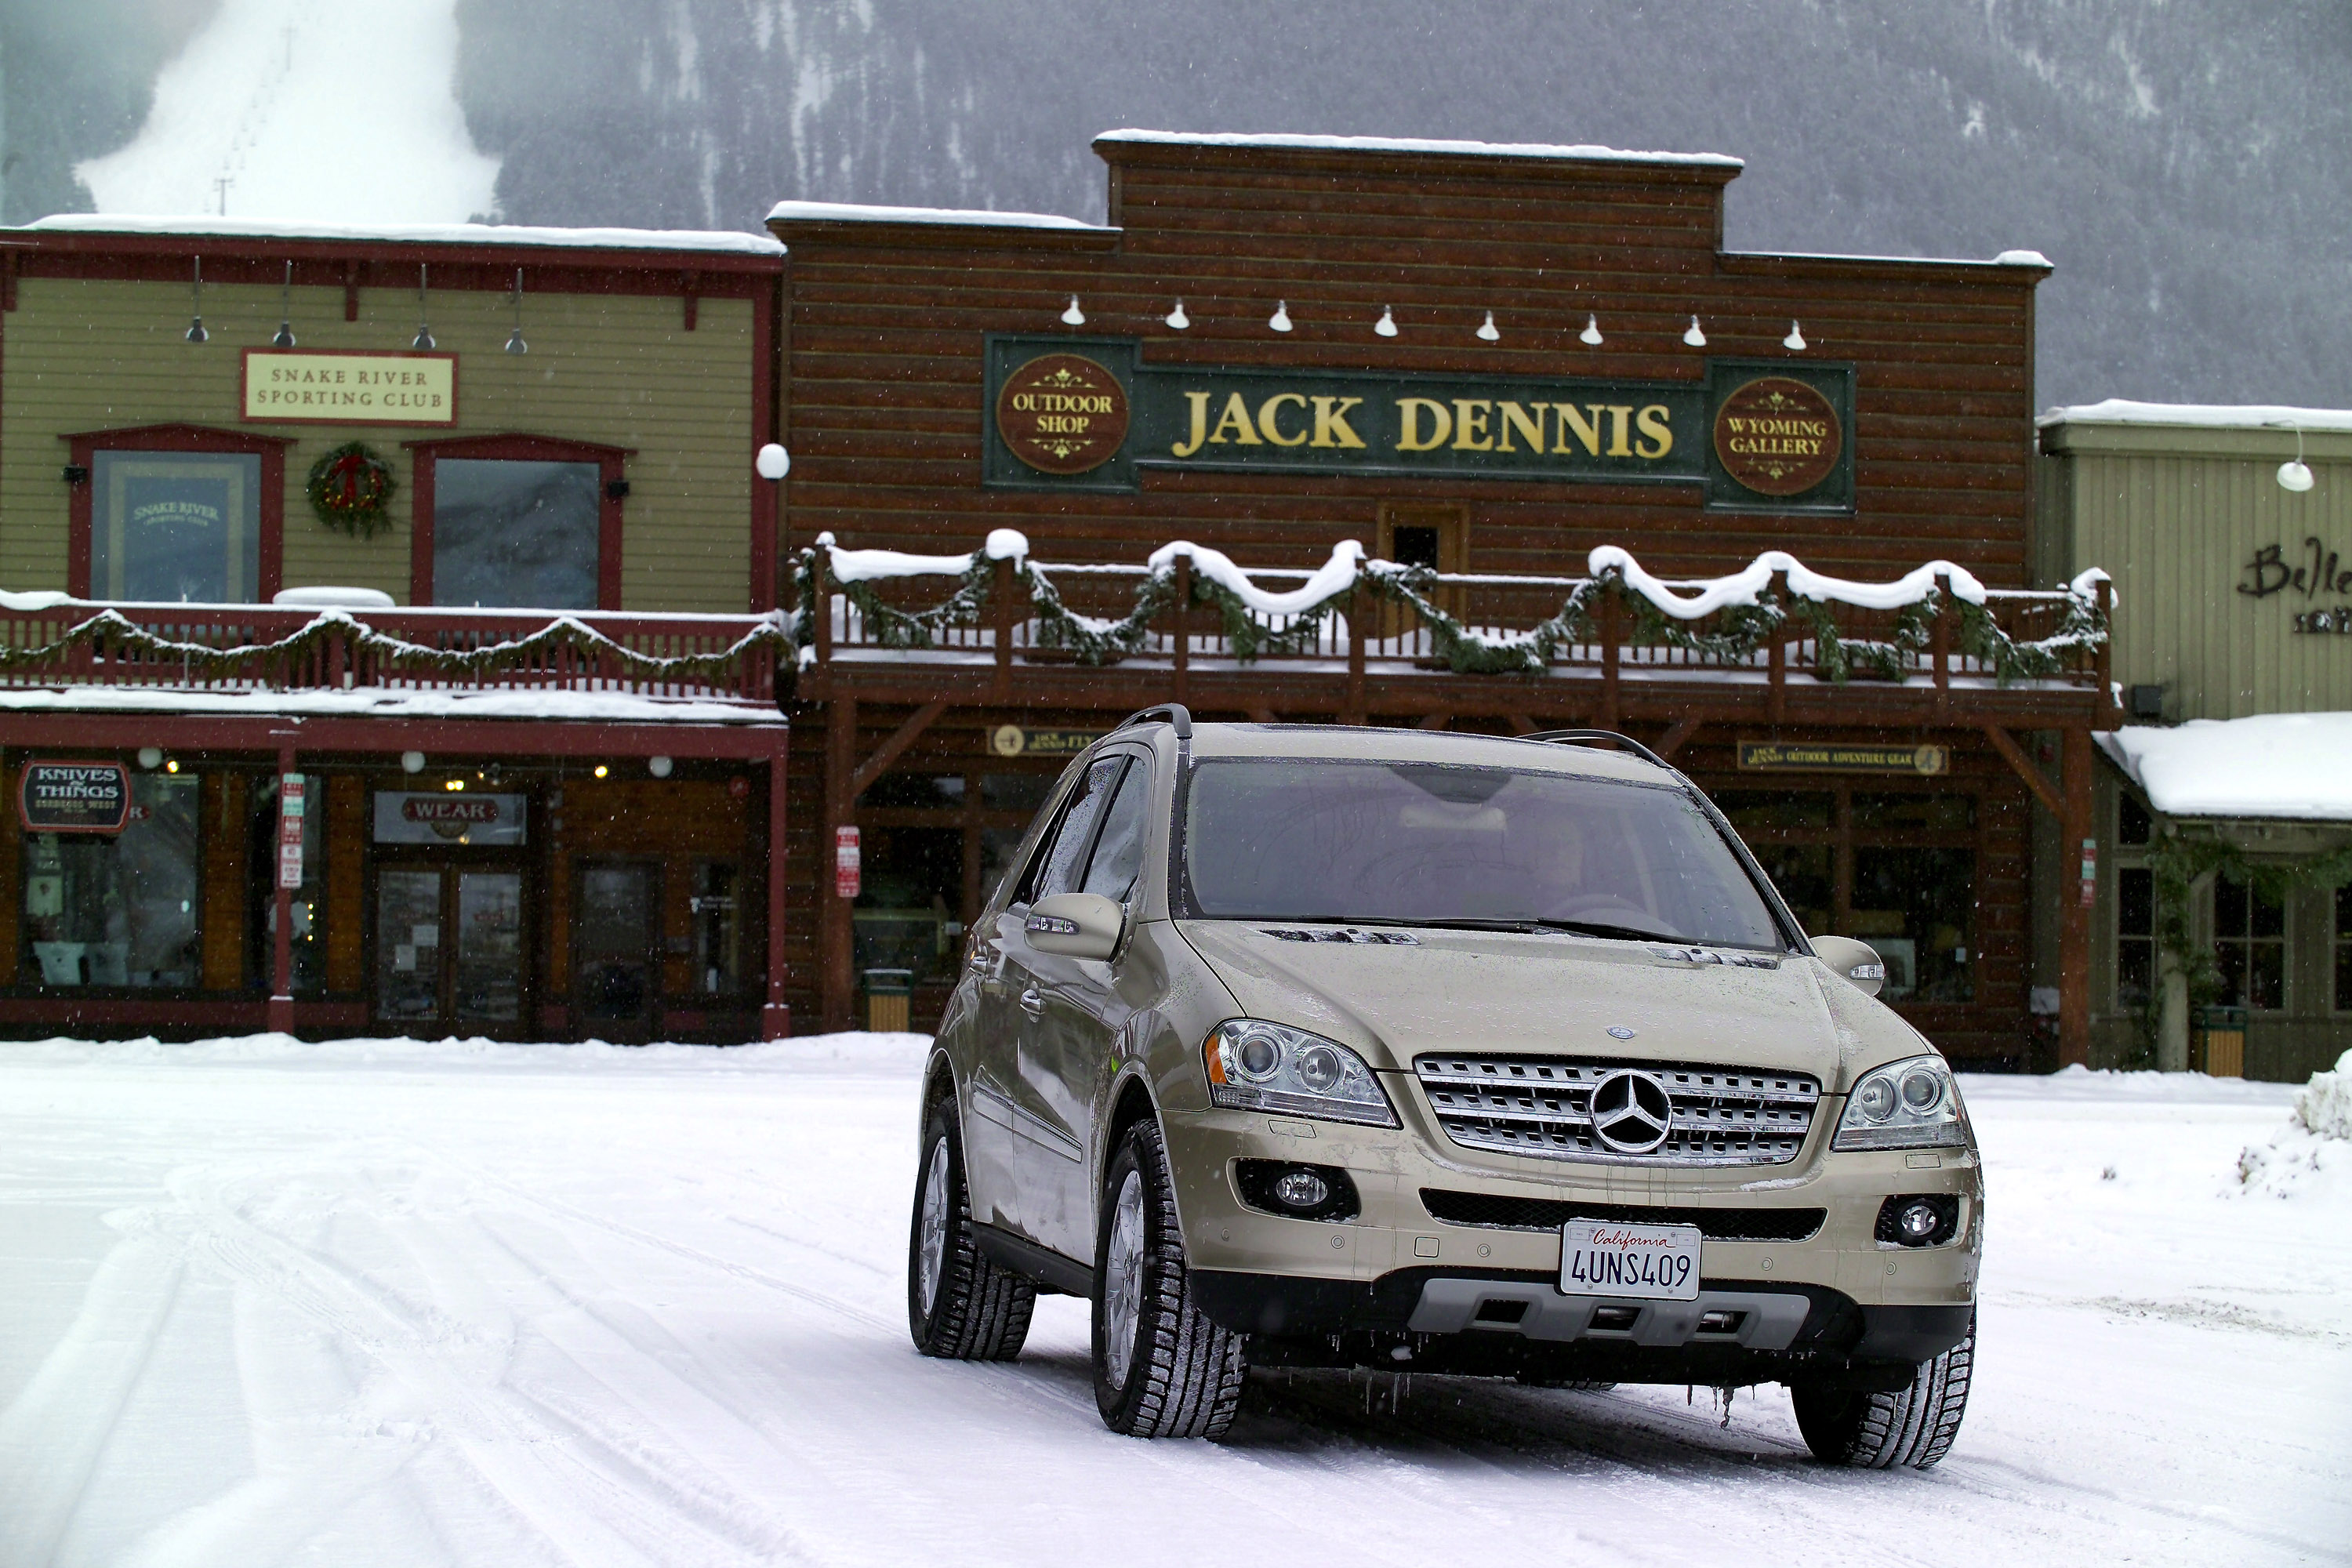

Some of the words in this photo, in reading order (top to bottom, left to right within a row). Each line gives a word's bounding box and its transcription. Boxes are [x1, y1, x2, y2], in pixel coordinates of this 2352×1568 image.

[271, 368, 346, 384] SNAKE
[358, 371, 427, 386] RIVER
[257, 390, 372, 406] SPORTING
[383, 394, 442, 408] CLUB
[1013, 394, 1112, 413] OUTDOOR
[1036, 415, 1090, 433] SHOP
[1171, 391, 1367, 457] JACK
[1396, 397, 1674, 459] DENNIS
[1728, 417, 1827, 437] WYOMING
[1730, 437, 1823, 455] GALLERY
[180, 503, 220, 521] RIVER
[1787, 751, 1829, 763] OUTDOOR
[1834, 753, 1885, 764] ADVENTURE
[1888, 753, 1912, 764] GEAR
[38, 768, 117, 781] KNIVES
[36, 786, 118, 798] THINGS
[414, 803, 486, 818] WEAR
[1593, 1229, 1676, 1250] California
[1572, 1250, 1691, 1287] 4UNS409
